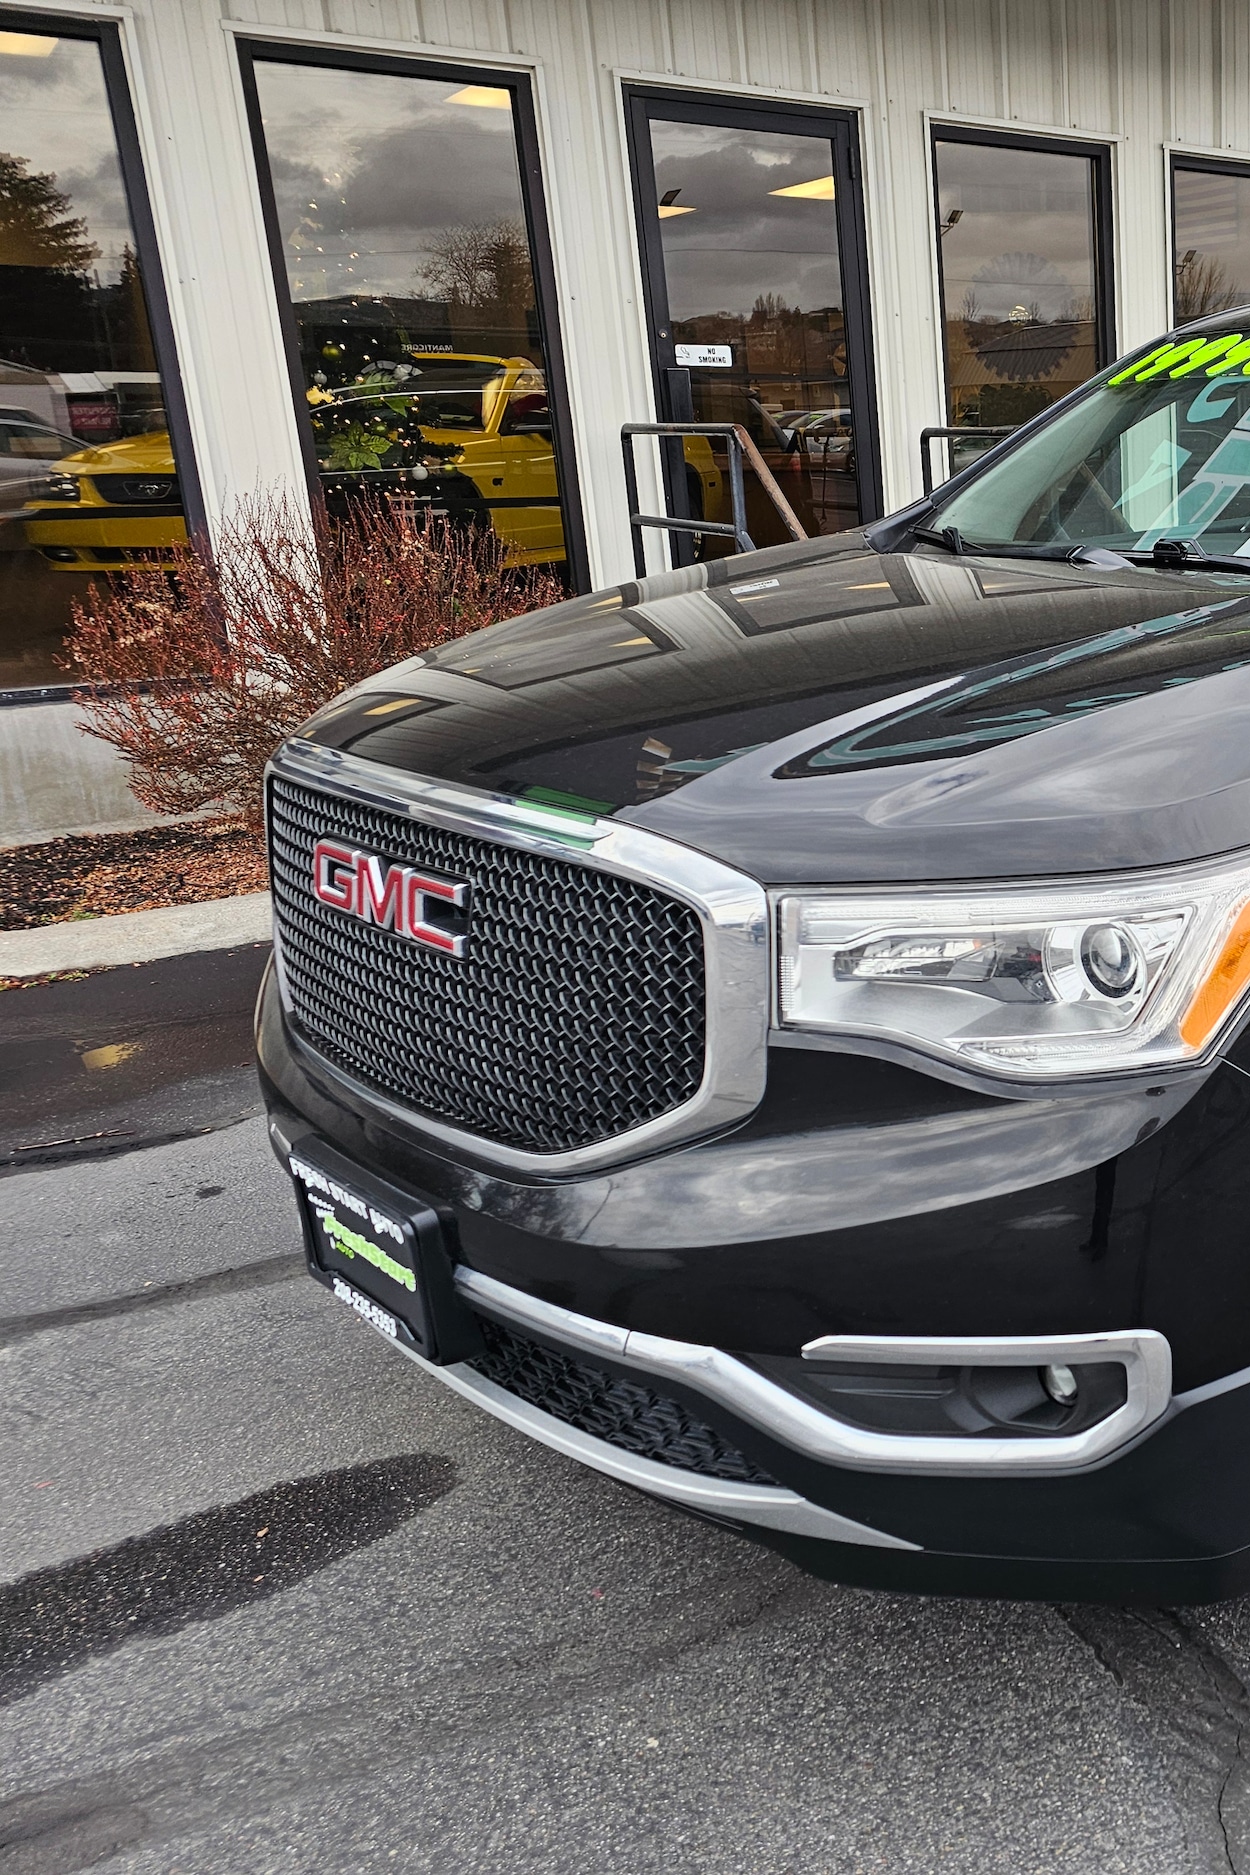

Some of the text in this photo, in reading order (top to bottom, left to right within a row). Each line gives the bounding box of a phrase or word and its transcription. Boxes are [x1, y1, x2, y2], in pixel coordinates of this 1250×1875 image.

[707, 347, 716, 355] NO
[698, 356, 727, 364] SMOKING
[314, 838, 473, 960] GMC
